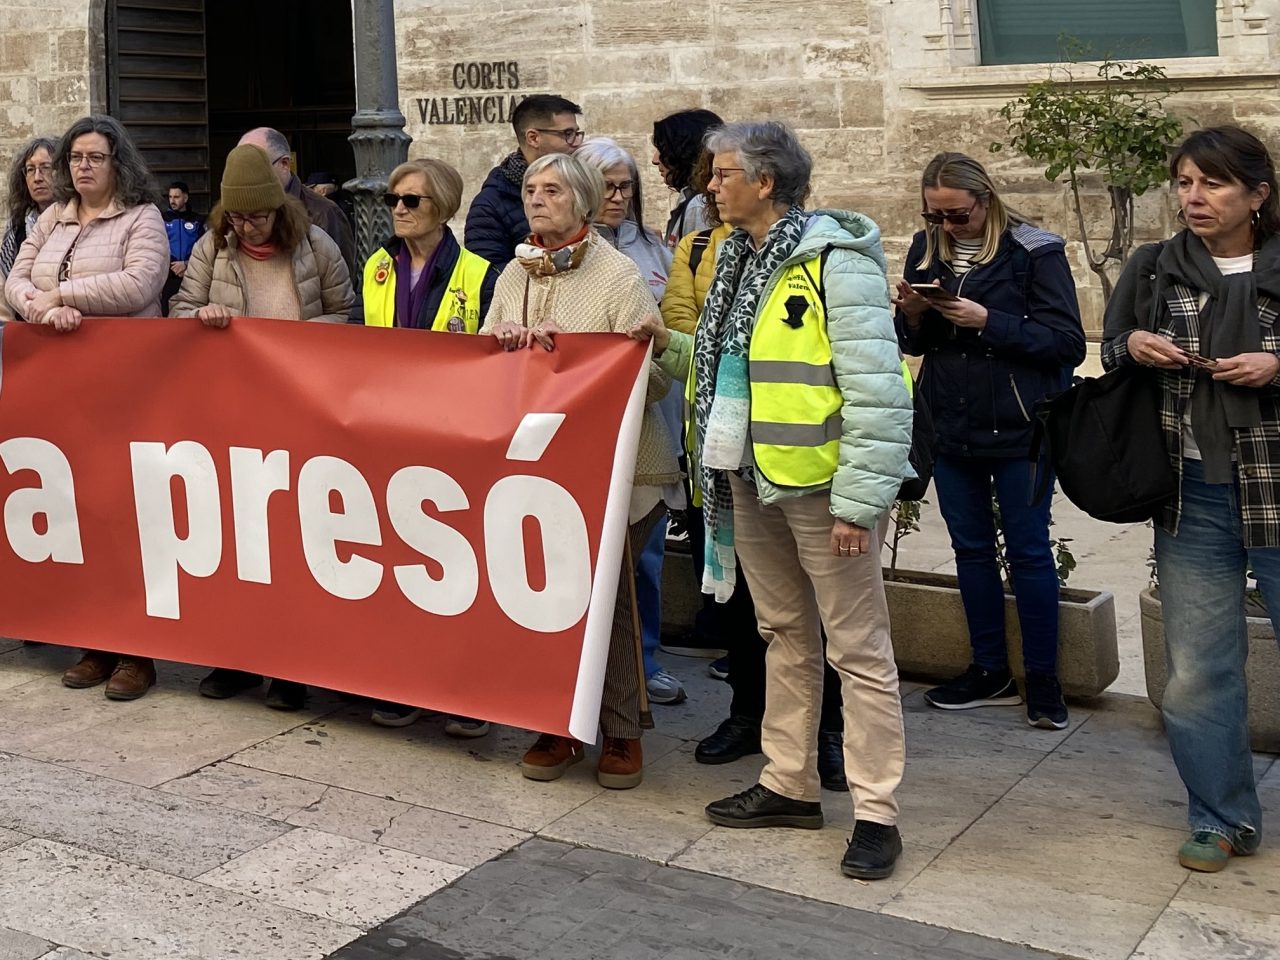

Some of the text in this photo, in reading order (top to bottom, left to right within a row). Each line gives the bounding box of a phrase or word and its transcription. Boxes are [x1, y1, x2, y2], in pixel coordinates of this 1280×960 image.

[452, 61, 520, 90] CORTS
[416, 94, 527, 125] VALENCIA
[129, 413, 593, 634] presó
